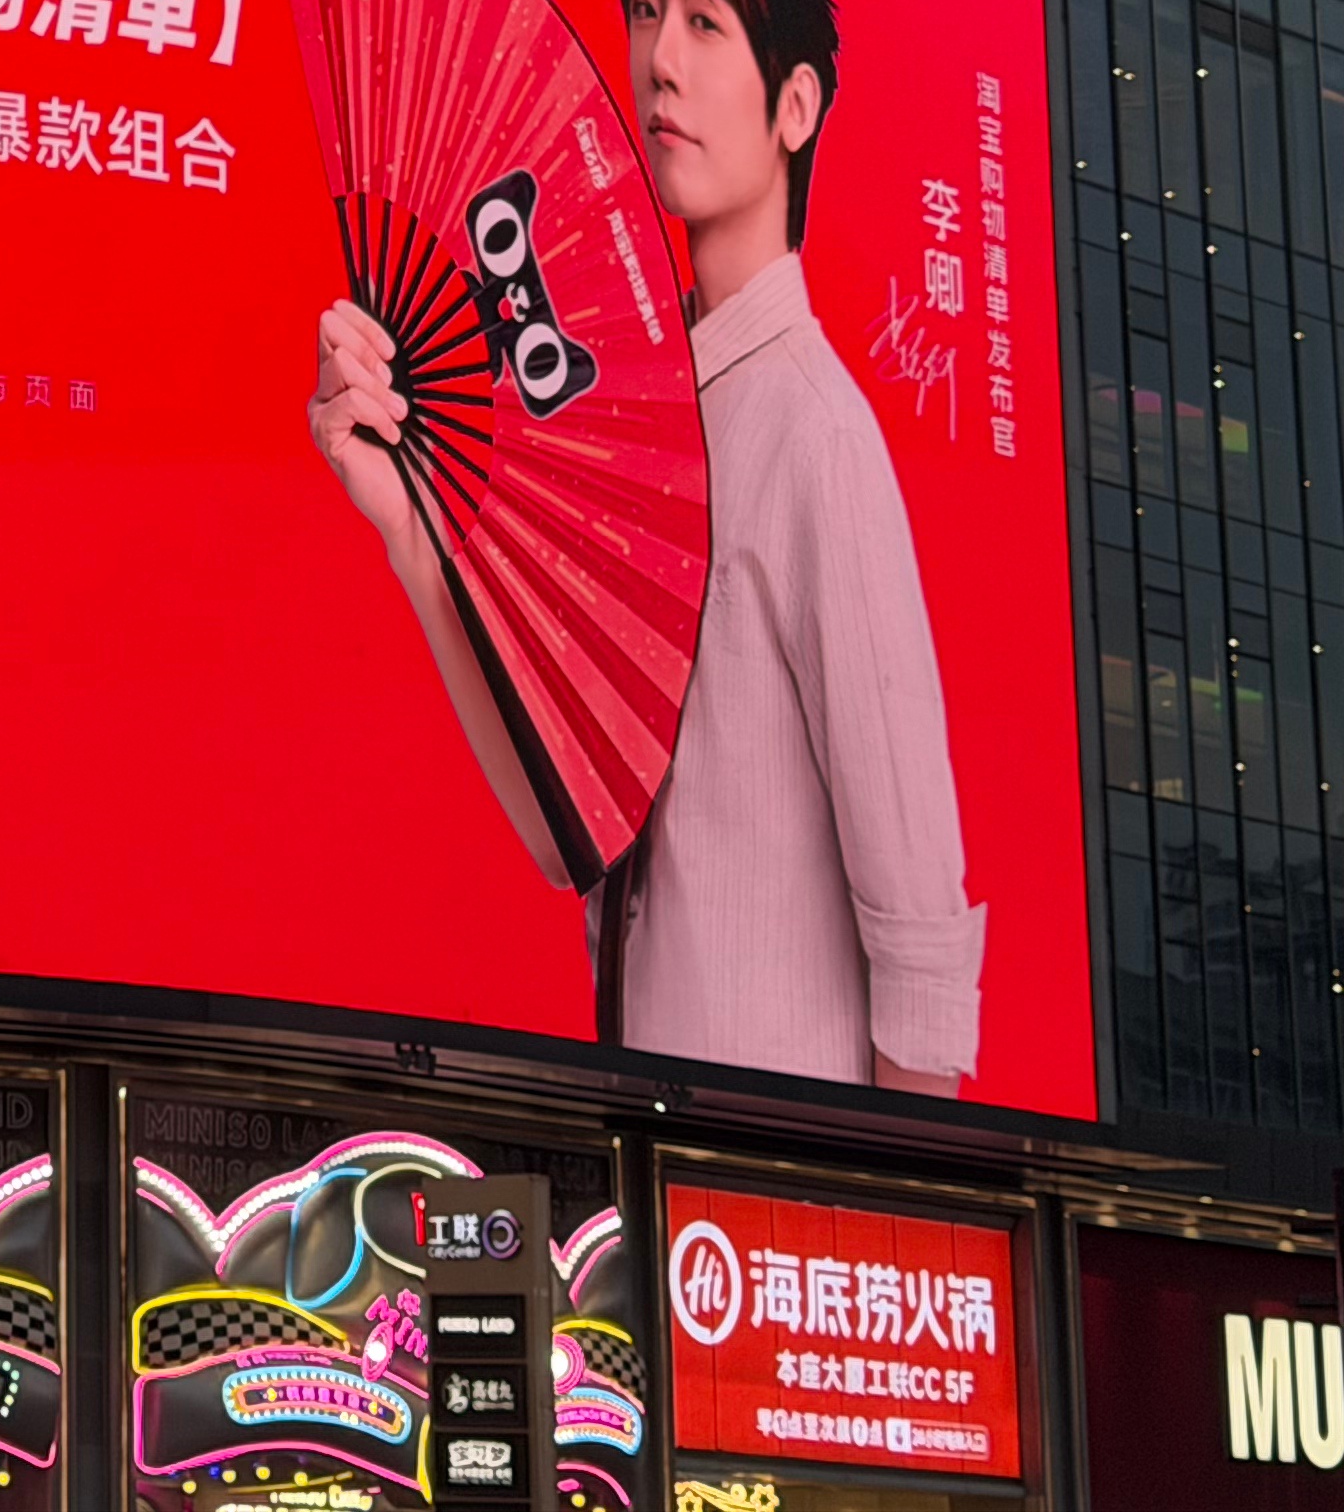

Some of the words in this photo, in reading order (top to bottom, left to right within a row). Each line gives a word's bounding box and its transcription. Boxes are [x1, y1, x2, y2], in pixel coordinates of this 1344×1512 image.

[921, 178, 965, 318] 李卿
[747, 1246, 997, 1357] 海底捞火锅
[944, 1368, 975, 1405] 5F
